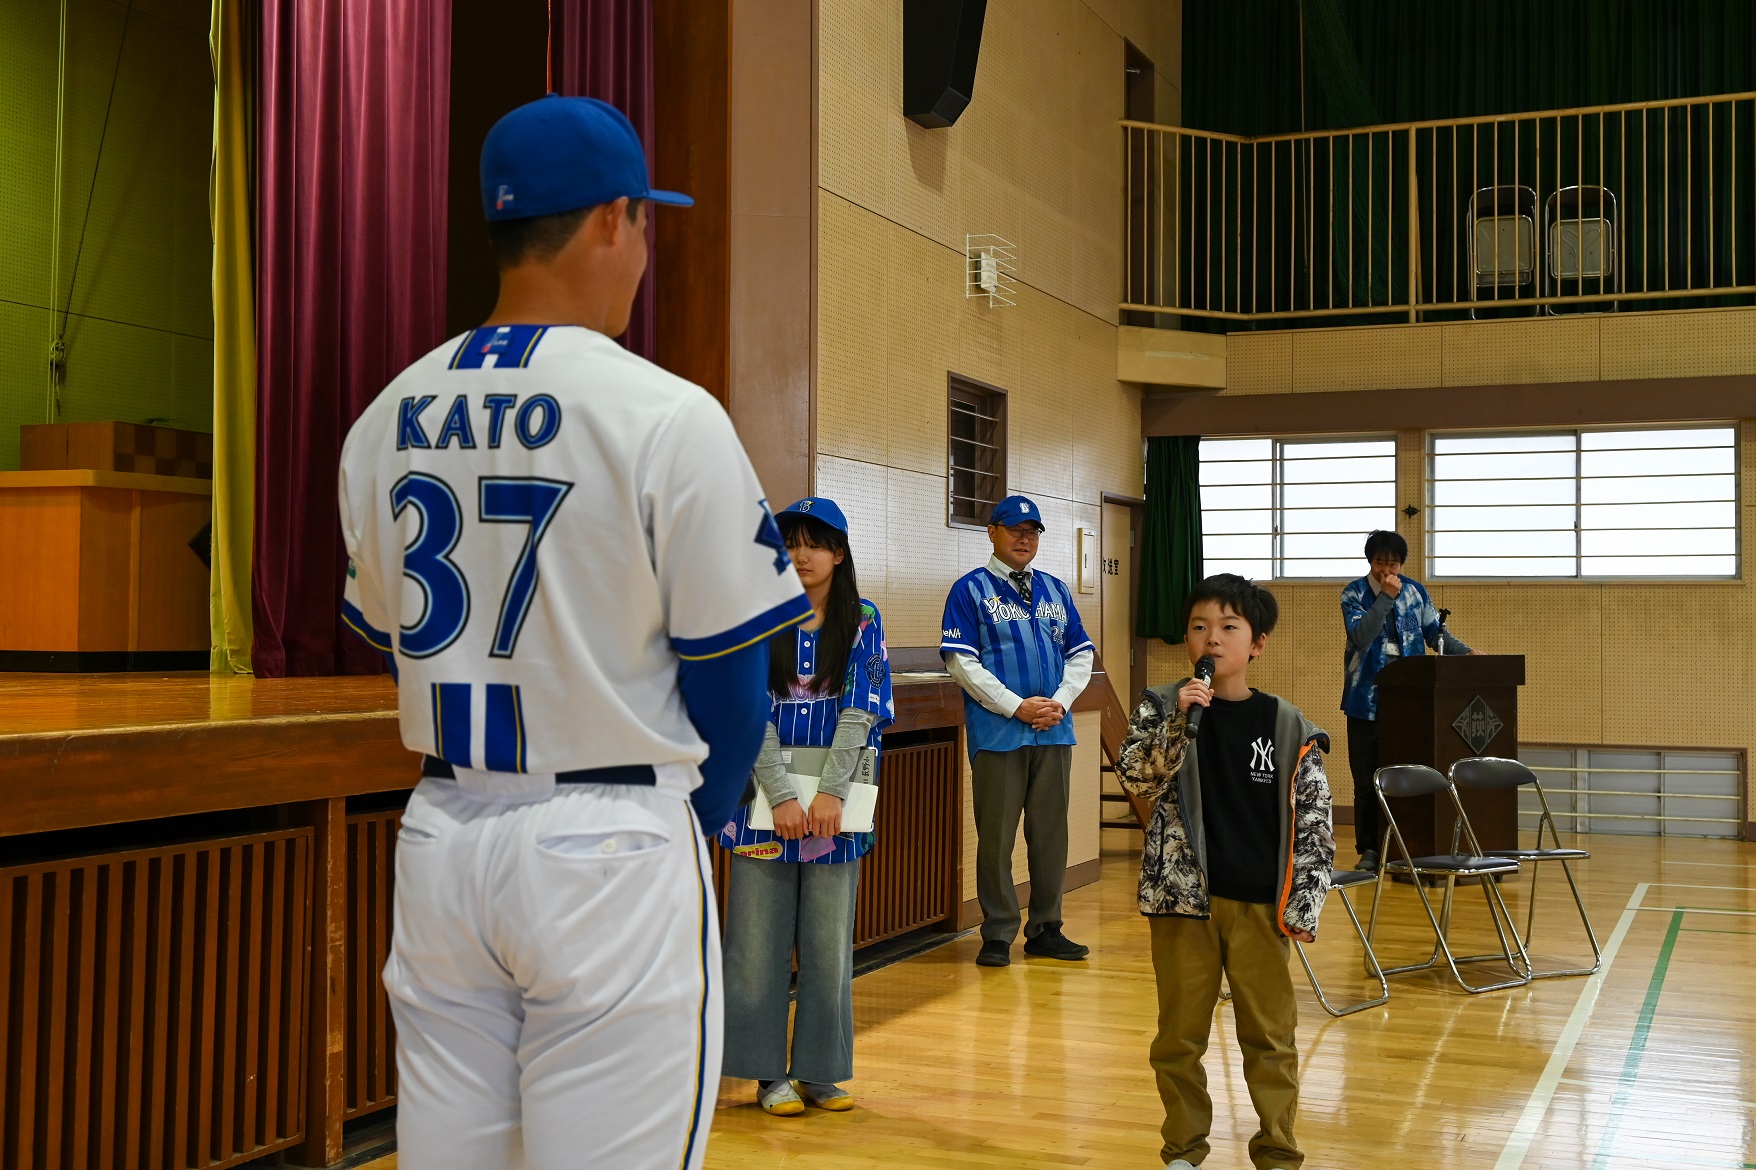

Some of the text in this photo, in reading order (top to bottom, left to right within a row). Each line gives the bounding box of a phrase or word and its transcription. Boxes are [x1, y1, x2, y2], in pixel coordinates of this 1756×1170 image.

[396, 393, 562, 451] KATO
[389, 470, 575, 660] 37
[1250, 736, 1275, 771] NY
